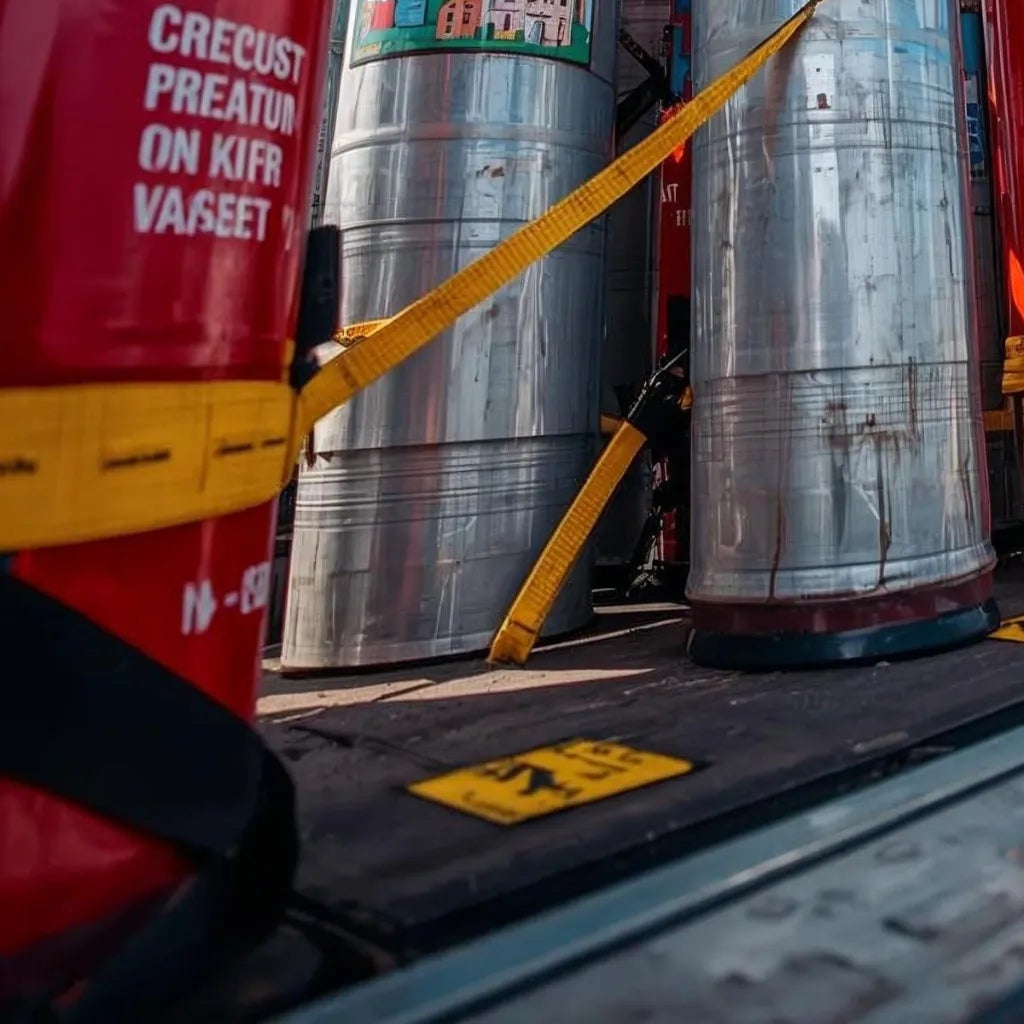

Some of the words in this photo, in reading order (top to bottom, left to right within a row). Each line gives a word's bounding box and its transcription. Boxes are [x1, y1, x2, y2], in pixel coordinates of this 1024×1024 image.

[148, 3, 305, 84] CRECUST
[138, 123, 201, 176] ON
[208, 133, 284, 188] KIFR
